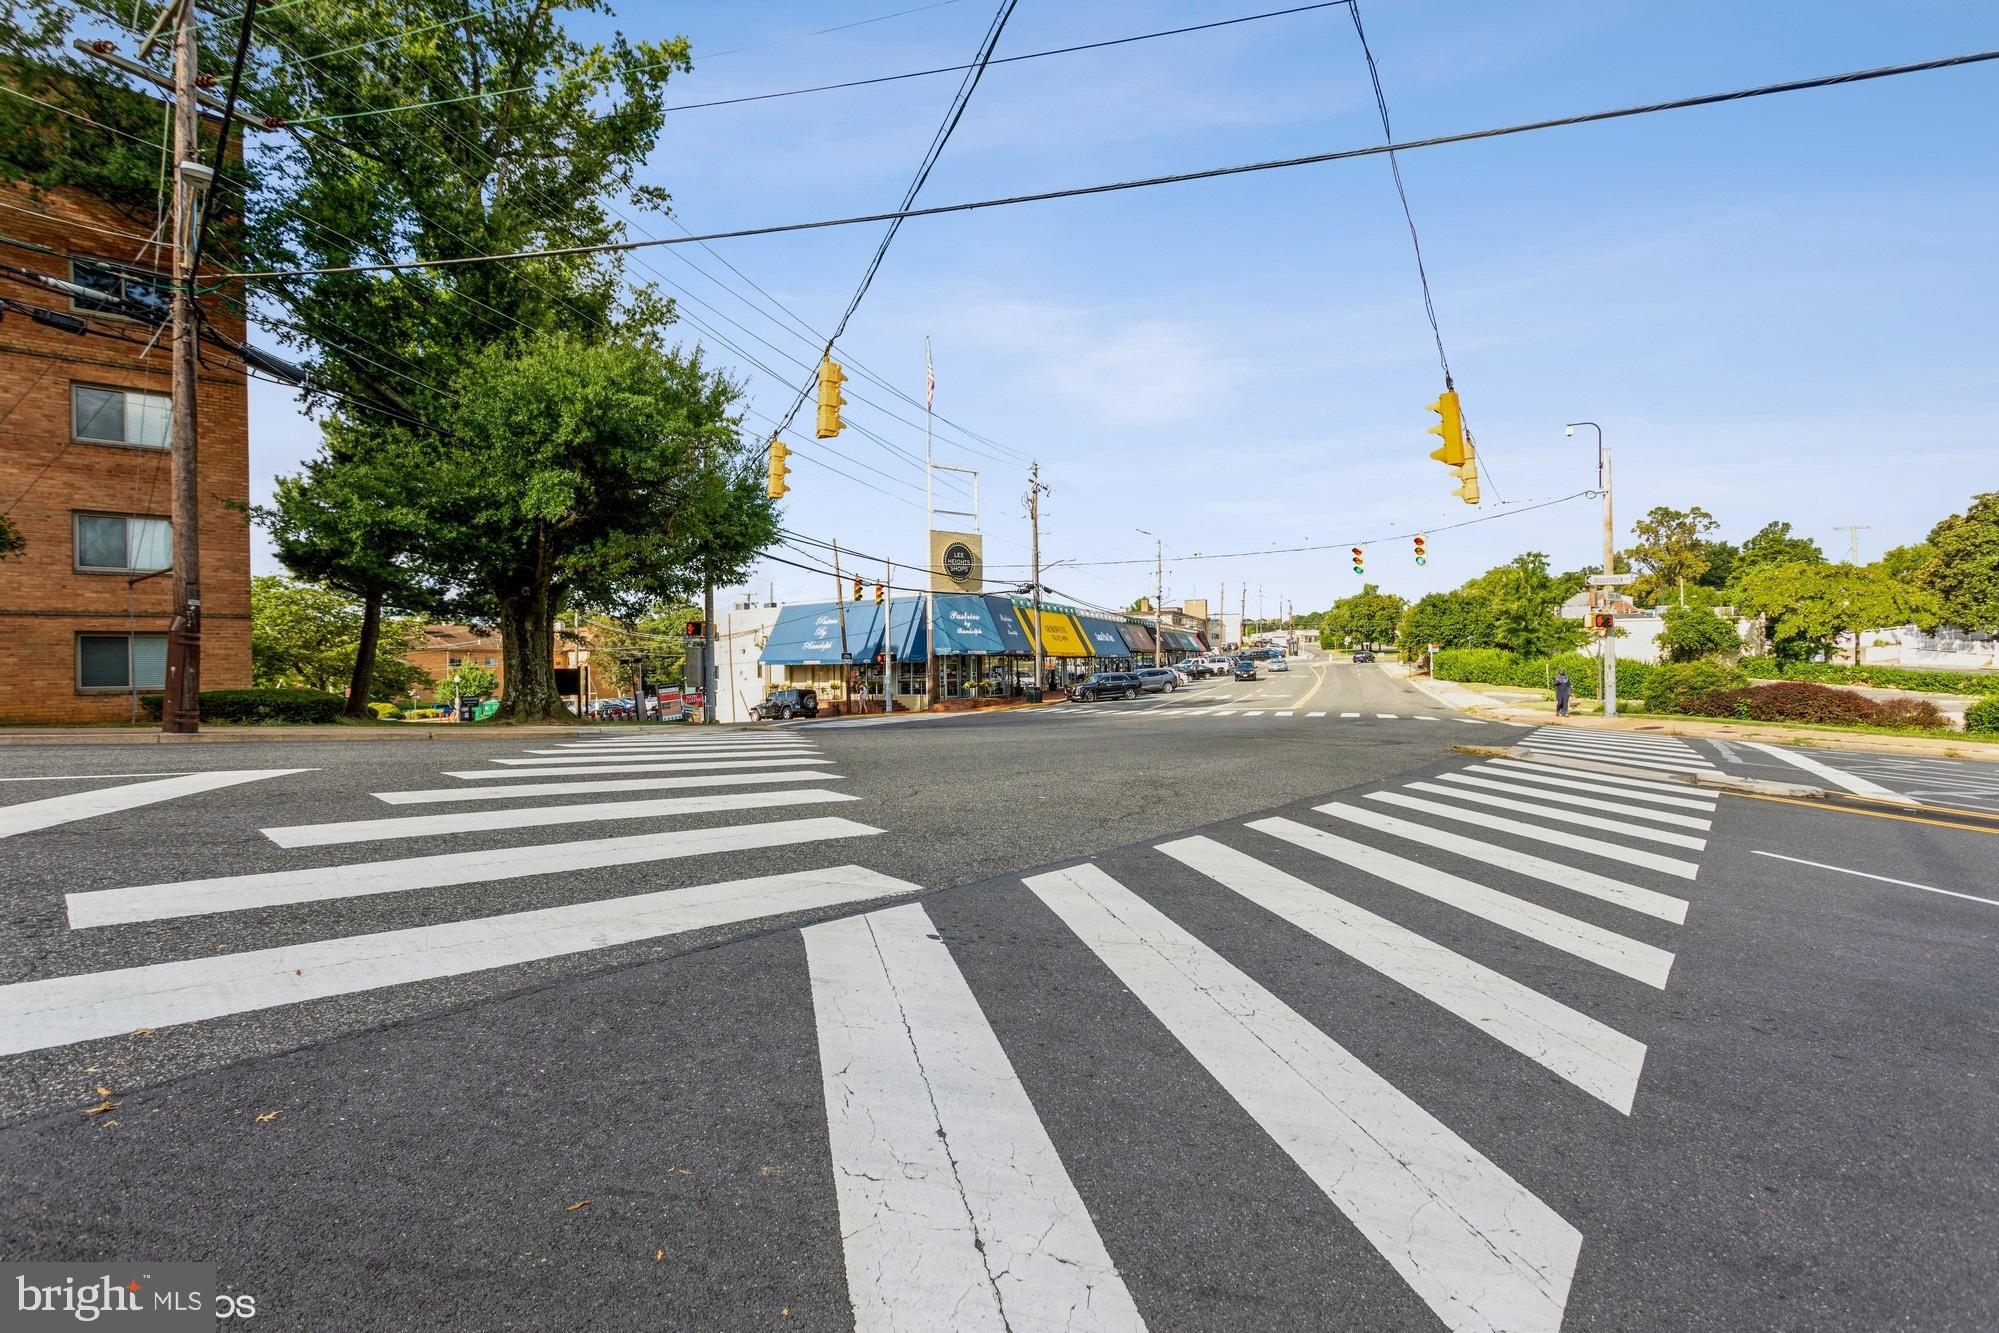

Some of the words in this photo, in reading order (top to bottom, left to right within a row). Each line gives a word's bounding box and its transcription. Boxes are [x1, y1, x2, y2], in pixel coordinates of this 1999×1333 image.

[949, 565, 969, 573] SHOPS
[949, 610, 981, 620] Pastries
[956, 628, 983, 637] Randolph
